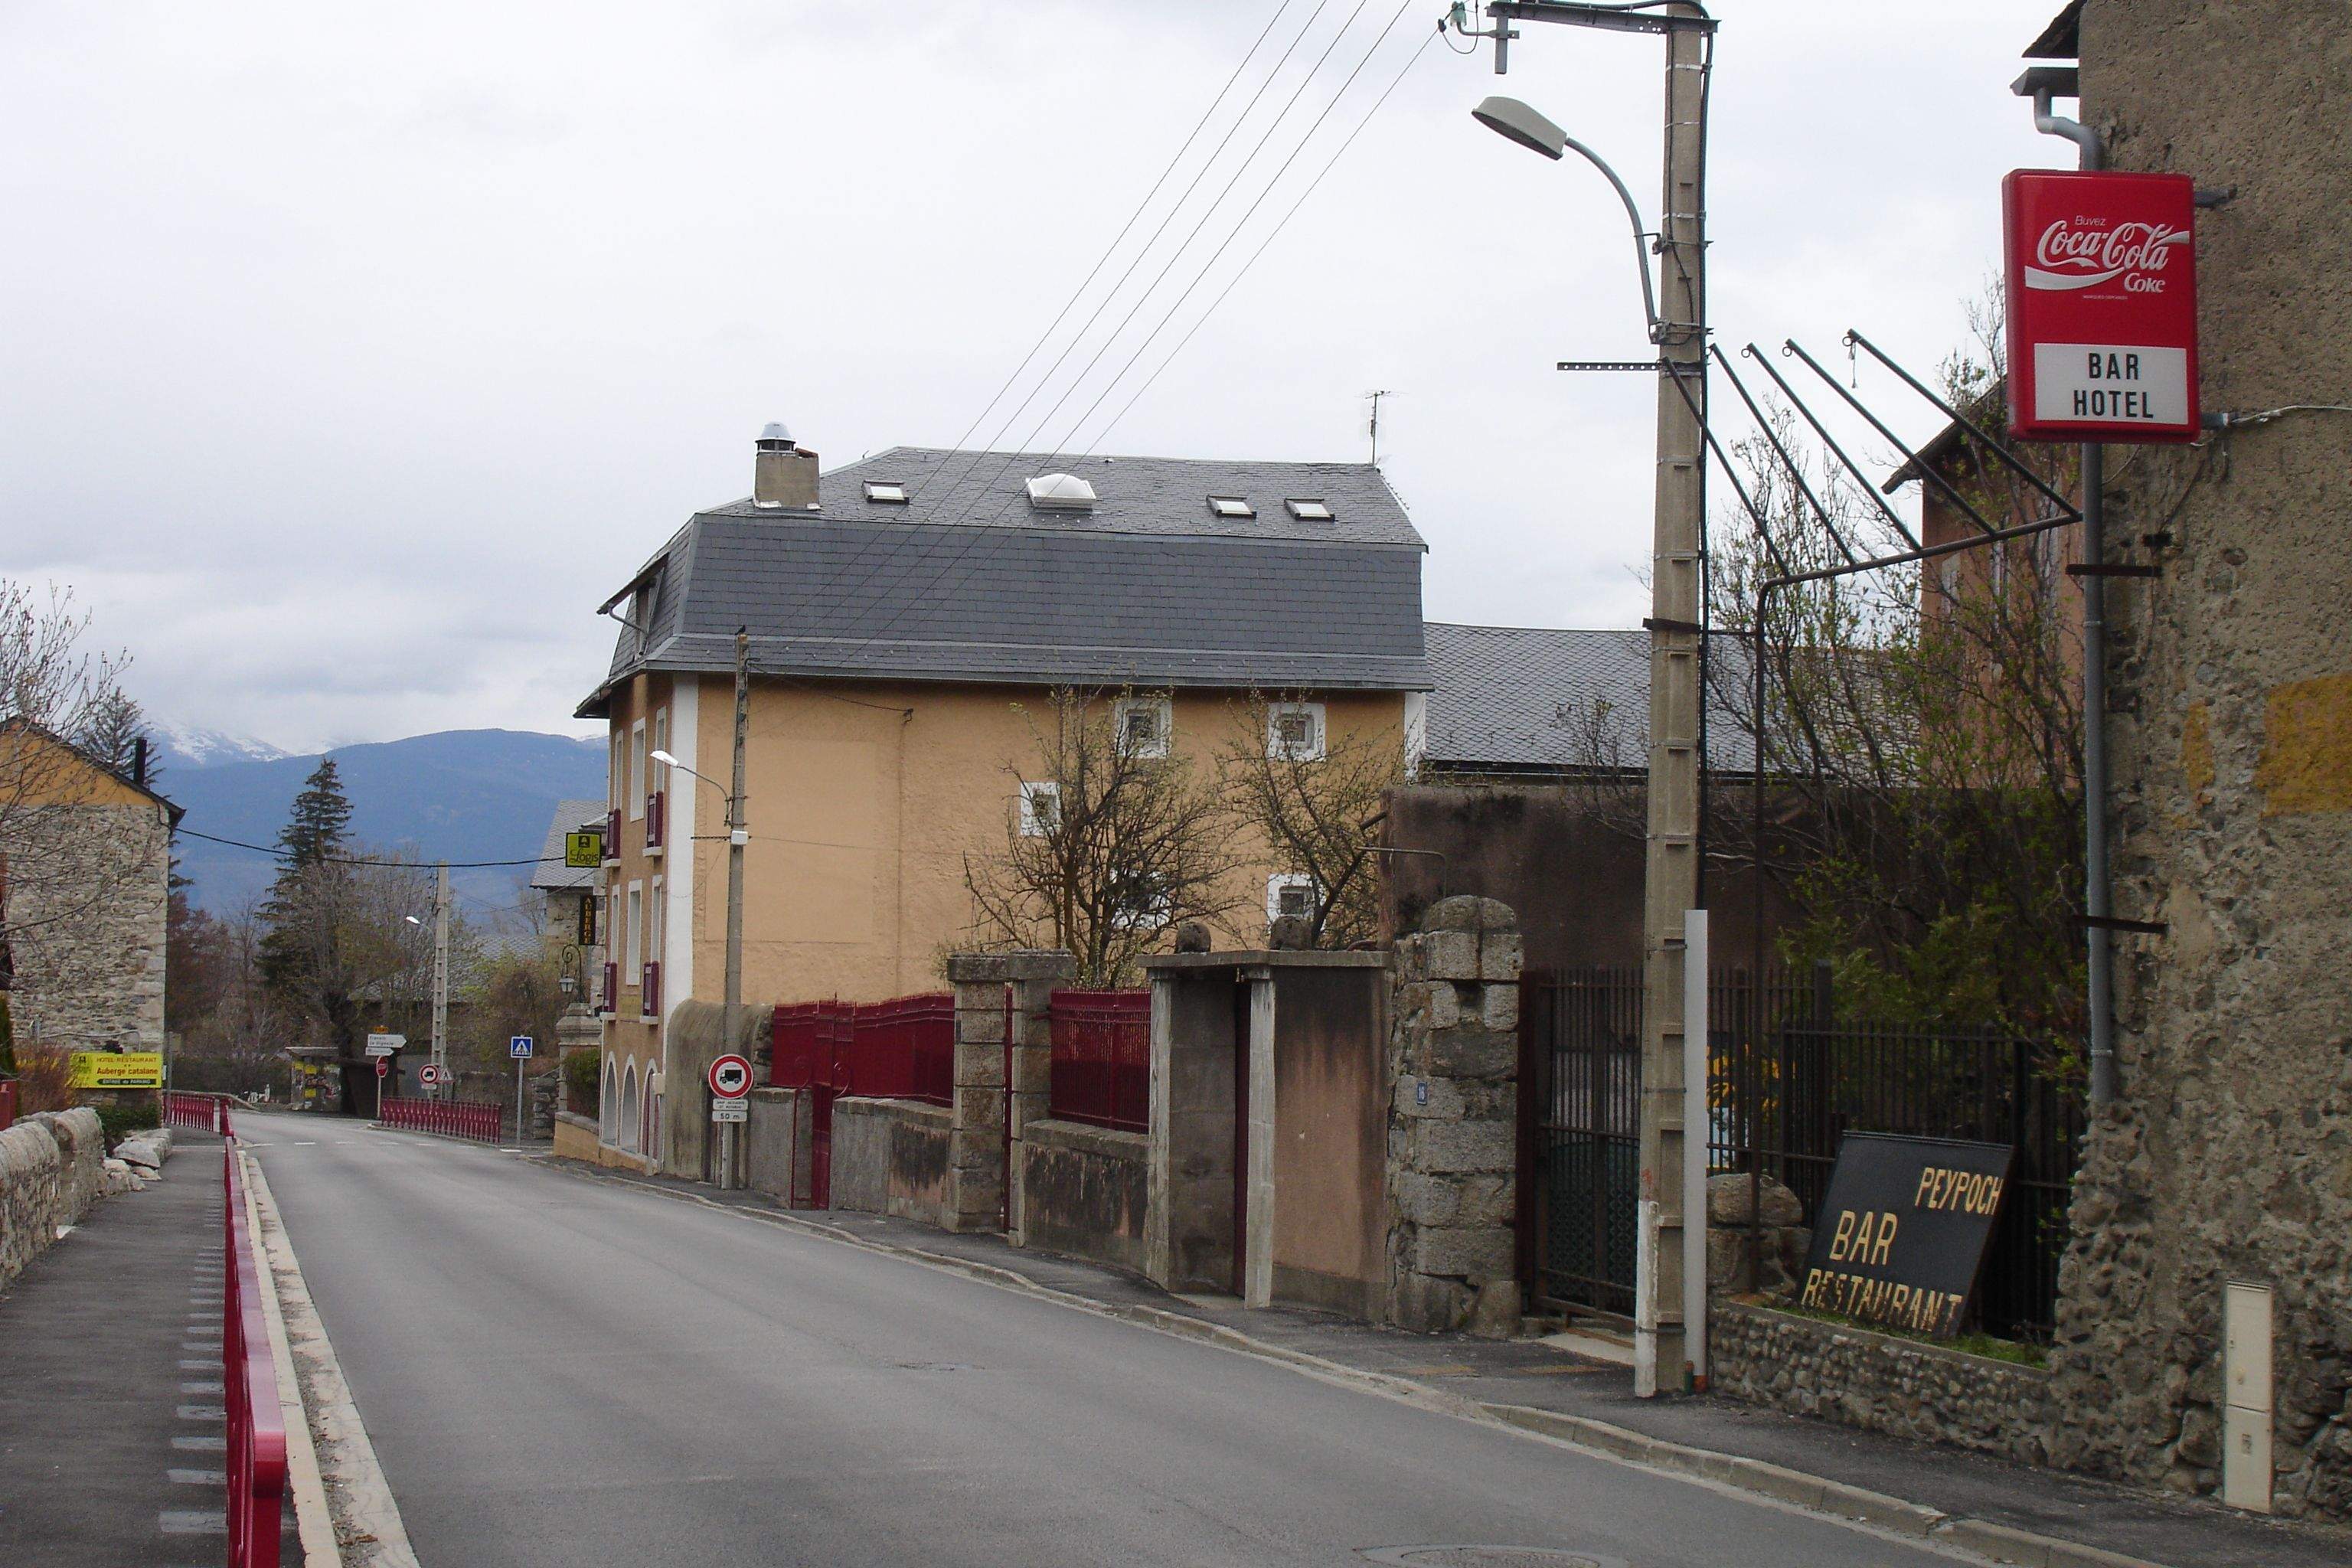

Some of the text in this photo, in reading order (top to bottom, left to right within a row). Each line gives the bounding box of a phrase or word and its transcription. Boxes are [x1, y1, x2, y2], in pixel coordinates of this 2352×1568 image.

[2075, 215, 2105, 226] Buvez
[2037, 220, 2173, 270] Coca-Cola
[2124, 273, 2166, 292] Coke
[2089, 353, 2138, 380] BAR
[2073, 390, 2154, 419] HOTEL
[96, 1067, 126, 1076] Auberge
[1915, 1167, 2004, 1216] PEYPOCH
[1829, 1210, 1899, 1265] BAR
[1801, 1268, 1963, 1334] RESTAURANT
